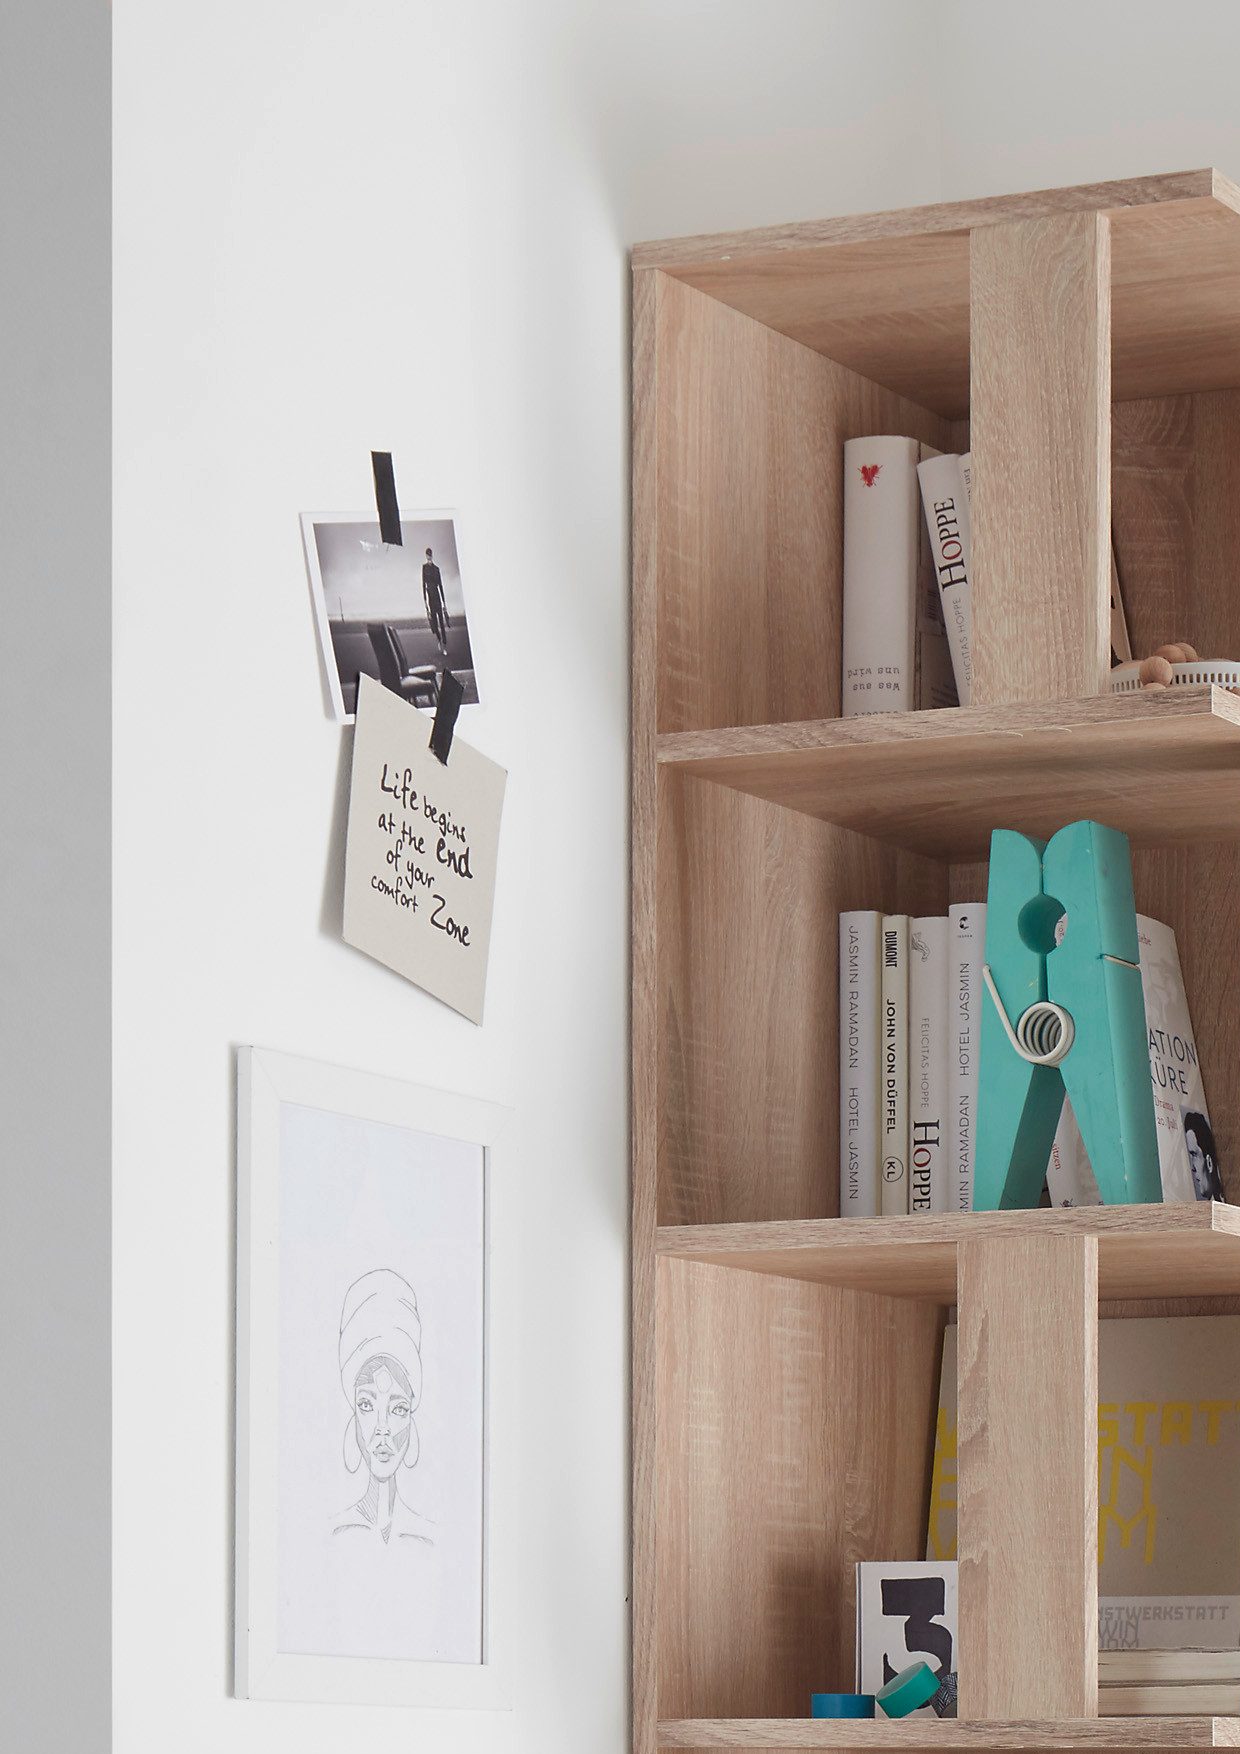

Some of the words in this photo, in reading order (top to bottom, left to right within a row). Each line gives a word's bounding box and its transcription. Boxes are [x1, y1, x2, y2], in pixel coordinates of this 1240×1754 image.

[934, 497, 968, 591] HOPPE
[952, 597, 965, 633] HOPPE
[847, 667, 873, 679] wird
[853, 681, 873, 691] aus
[877, 667, 900, 676] uns
[877, 681, 901, 692] Was
[380, 763, 419, 811] Life
[423, 795, 466, 842] begins
[377, 811, 396, 834] at
[401, 819, 426, 855] the
[435, 838, 472, 880] end
[386, 839, 403, 872] of
[406, 862, 436, 890] your
[370, 873, 419, 913] comfort
[429, 894, 472, 947] Zone
[847, 925, 859, 984] JASMIN
[884, 930, 898, 968] DUMONT
[960, 962, 969, 1021] JASMIN
[847, 991, 859, 1069] RAMADAN
[886, 998, 896, 1038] JOHN
[886, 1041, 896, 1072] VON
[921, 1017, 930, 1074] FELICITAS
[960, 1025, 969, 1077] HOTEL
[847, 1087, 859, 1135] HOTEL
[886, 1075, 898, 1134] DÜFFEL
[921, 1076, 930, 1109] HOPPE
[959, 1095, 969, 1174] RAMADAN
[847, 1141, 859, 1199] JASMIN
[887, 1160, 896, 1179] KL
[913, 1118, 940, 1211] HOPPE
[959, 1180, 969, 1213] MIN
